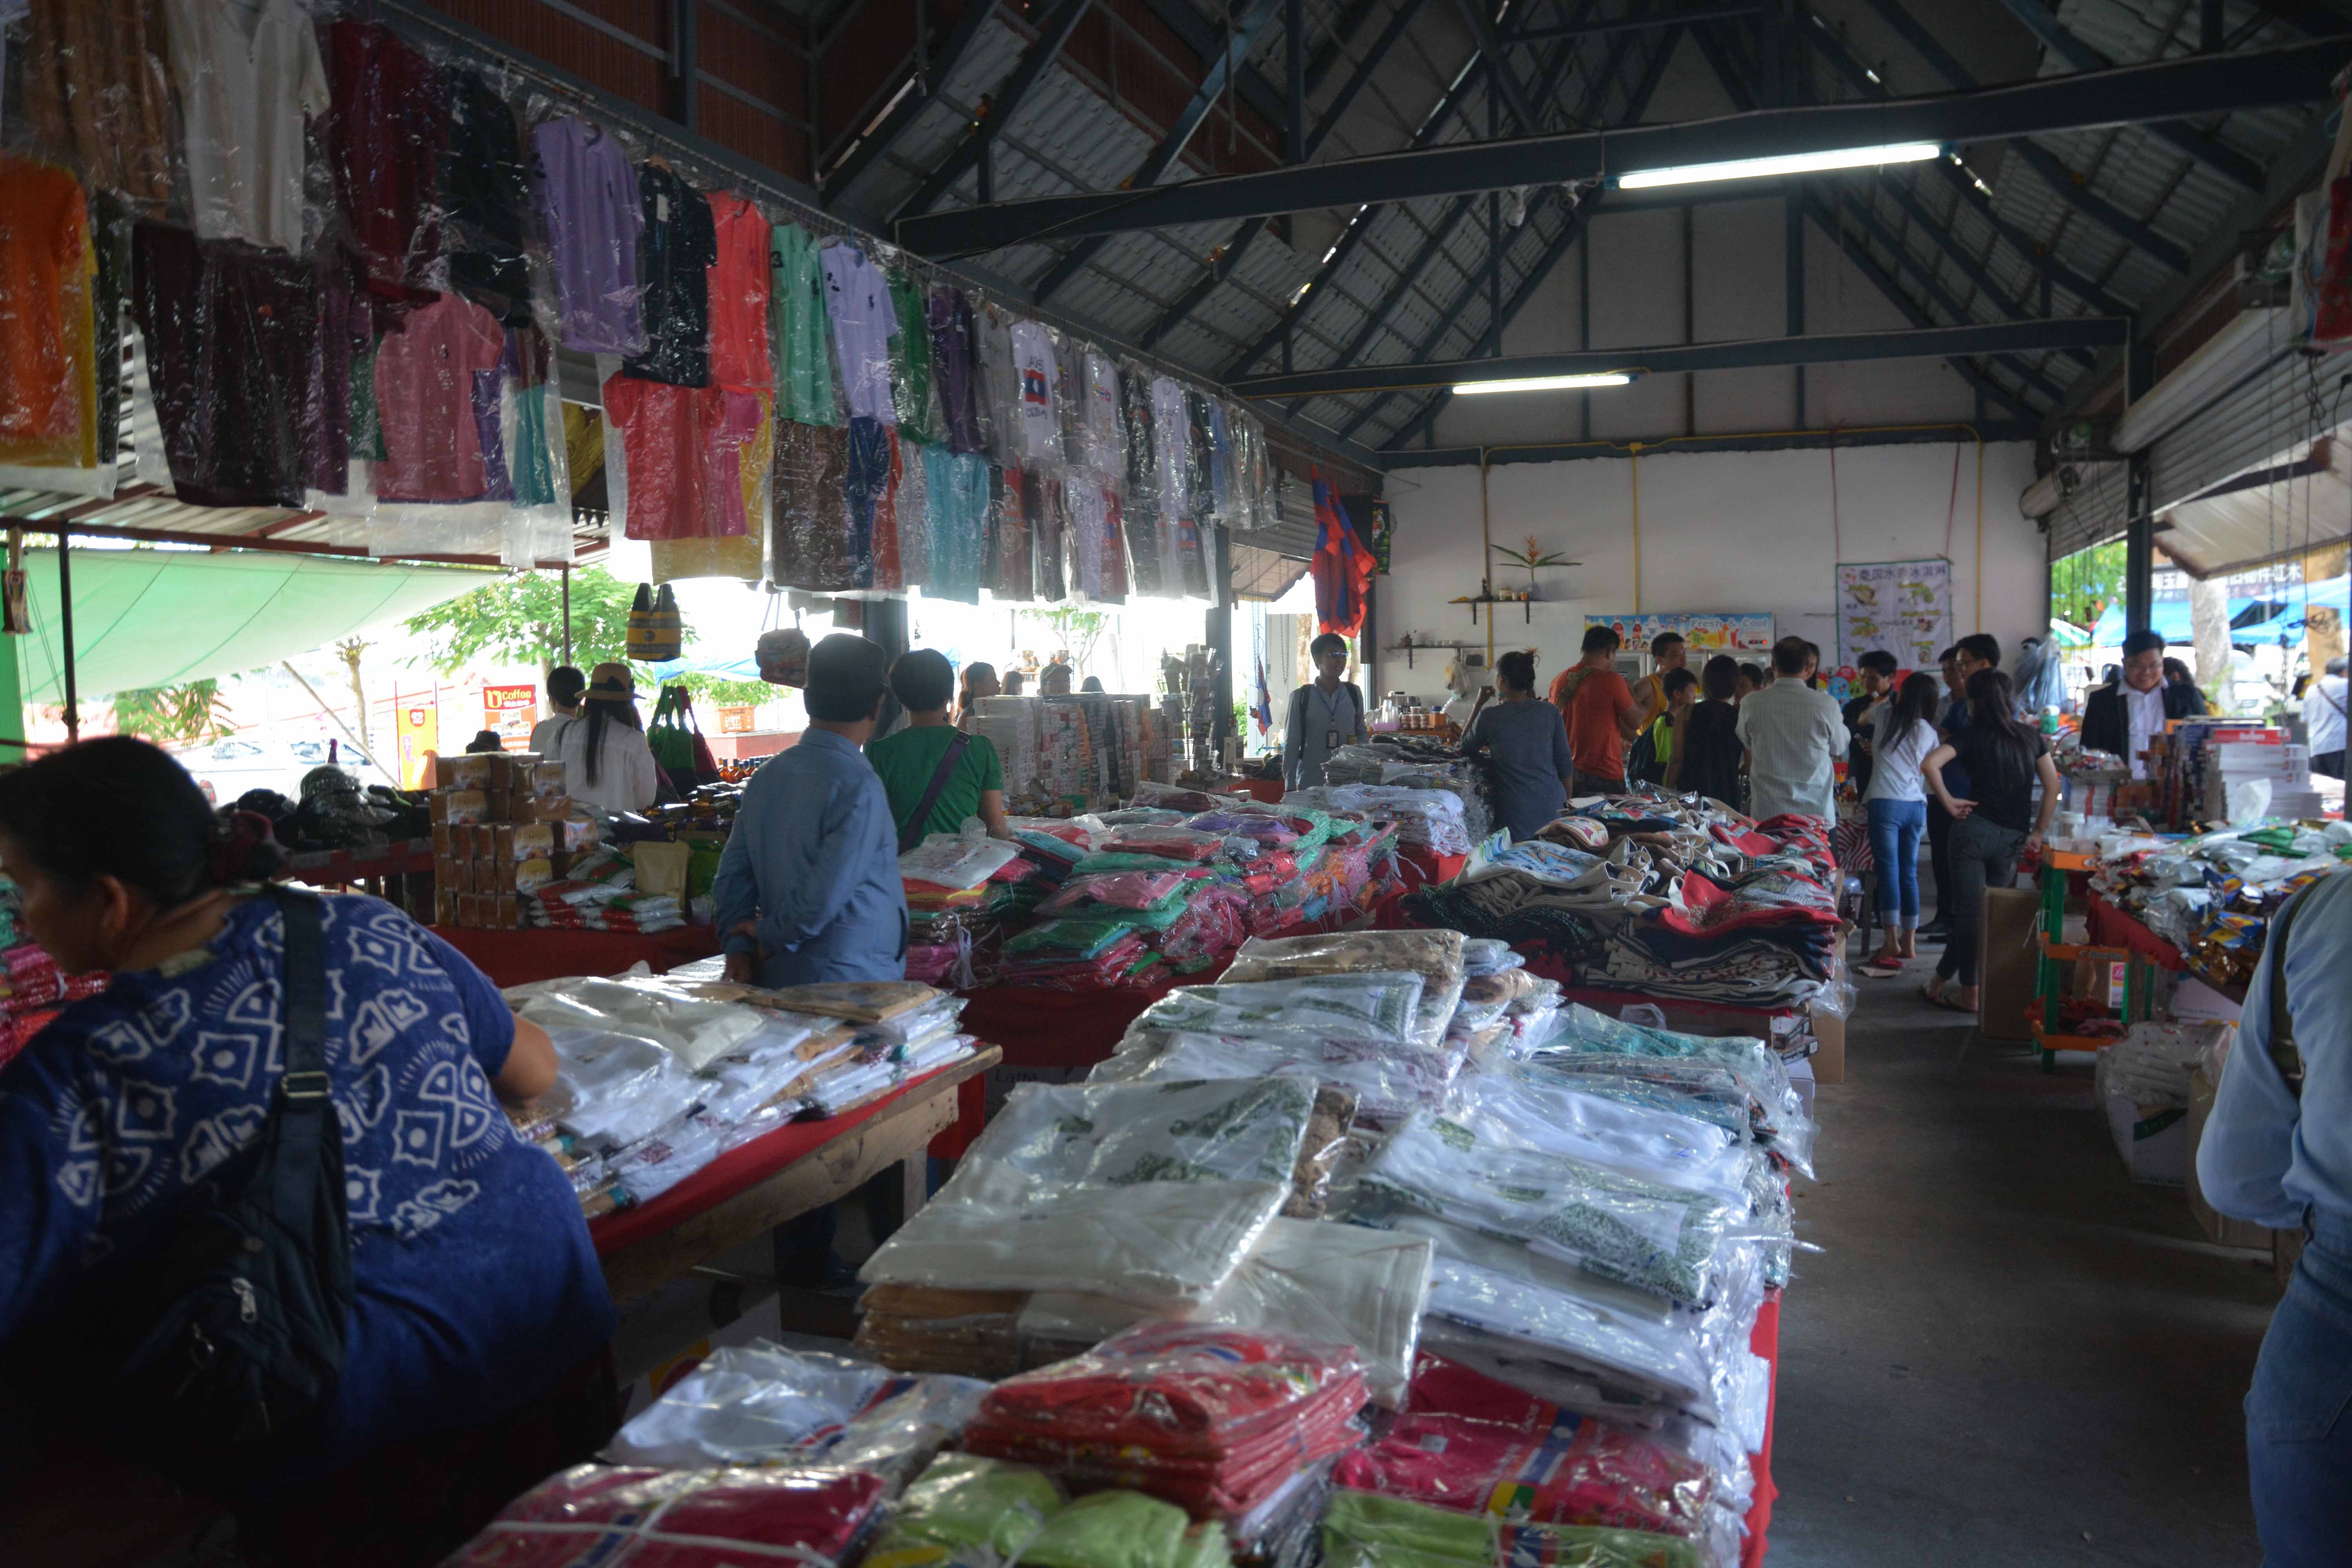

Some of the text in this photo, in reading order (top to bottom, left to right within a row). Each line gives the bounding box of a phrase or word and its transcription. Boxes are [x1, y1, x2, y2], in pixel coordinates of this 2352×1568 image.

[1691, 617, 1768, 628] Fresh & Cool
[502, 689, 532, 701] Coffee
